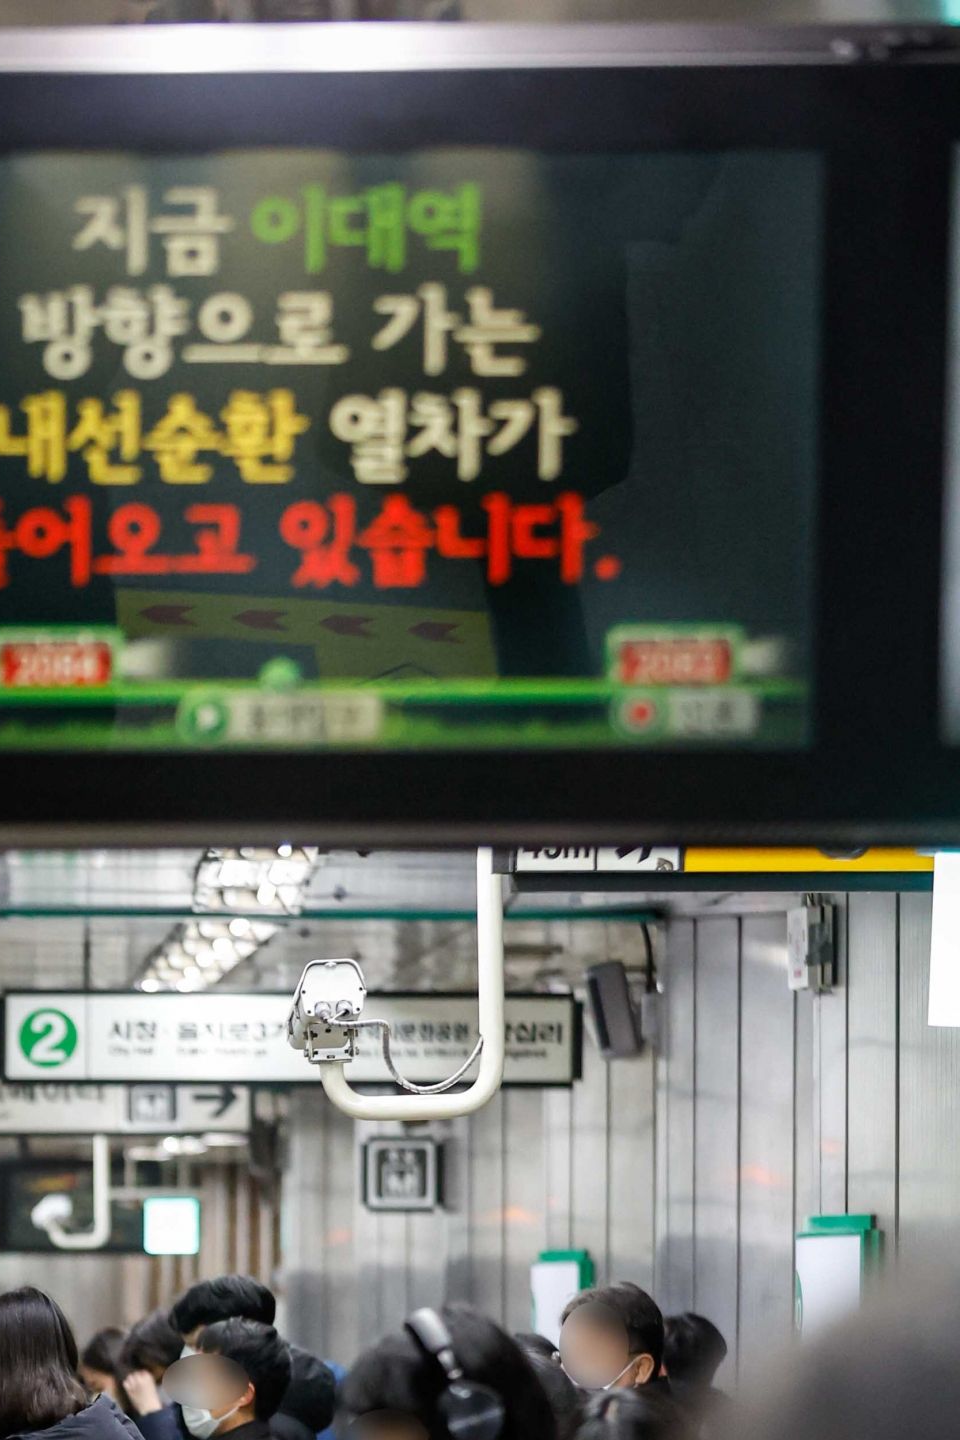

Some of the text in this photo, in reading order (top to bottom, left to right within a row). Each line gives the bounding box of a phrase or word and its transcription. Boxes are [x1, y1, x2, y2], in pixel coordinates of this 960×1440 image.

[75, 182, 486, 277] 지금 이대역
[18, 284, 542, 379] 방향으로 가는
[329, 387, 577, 482] 열차가
[278, 493, 622, 589] 있습니다.
[29, 1012, 67, 1064] 2
[111, 1021, 156, 1041] 시청
[504, 1023, 562, 1046] 십리
